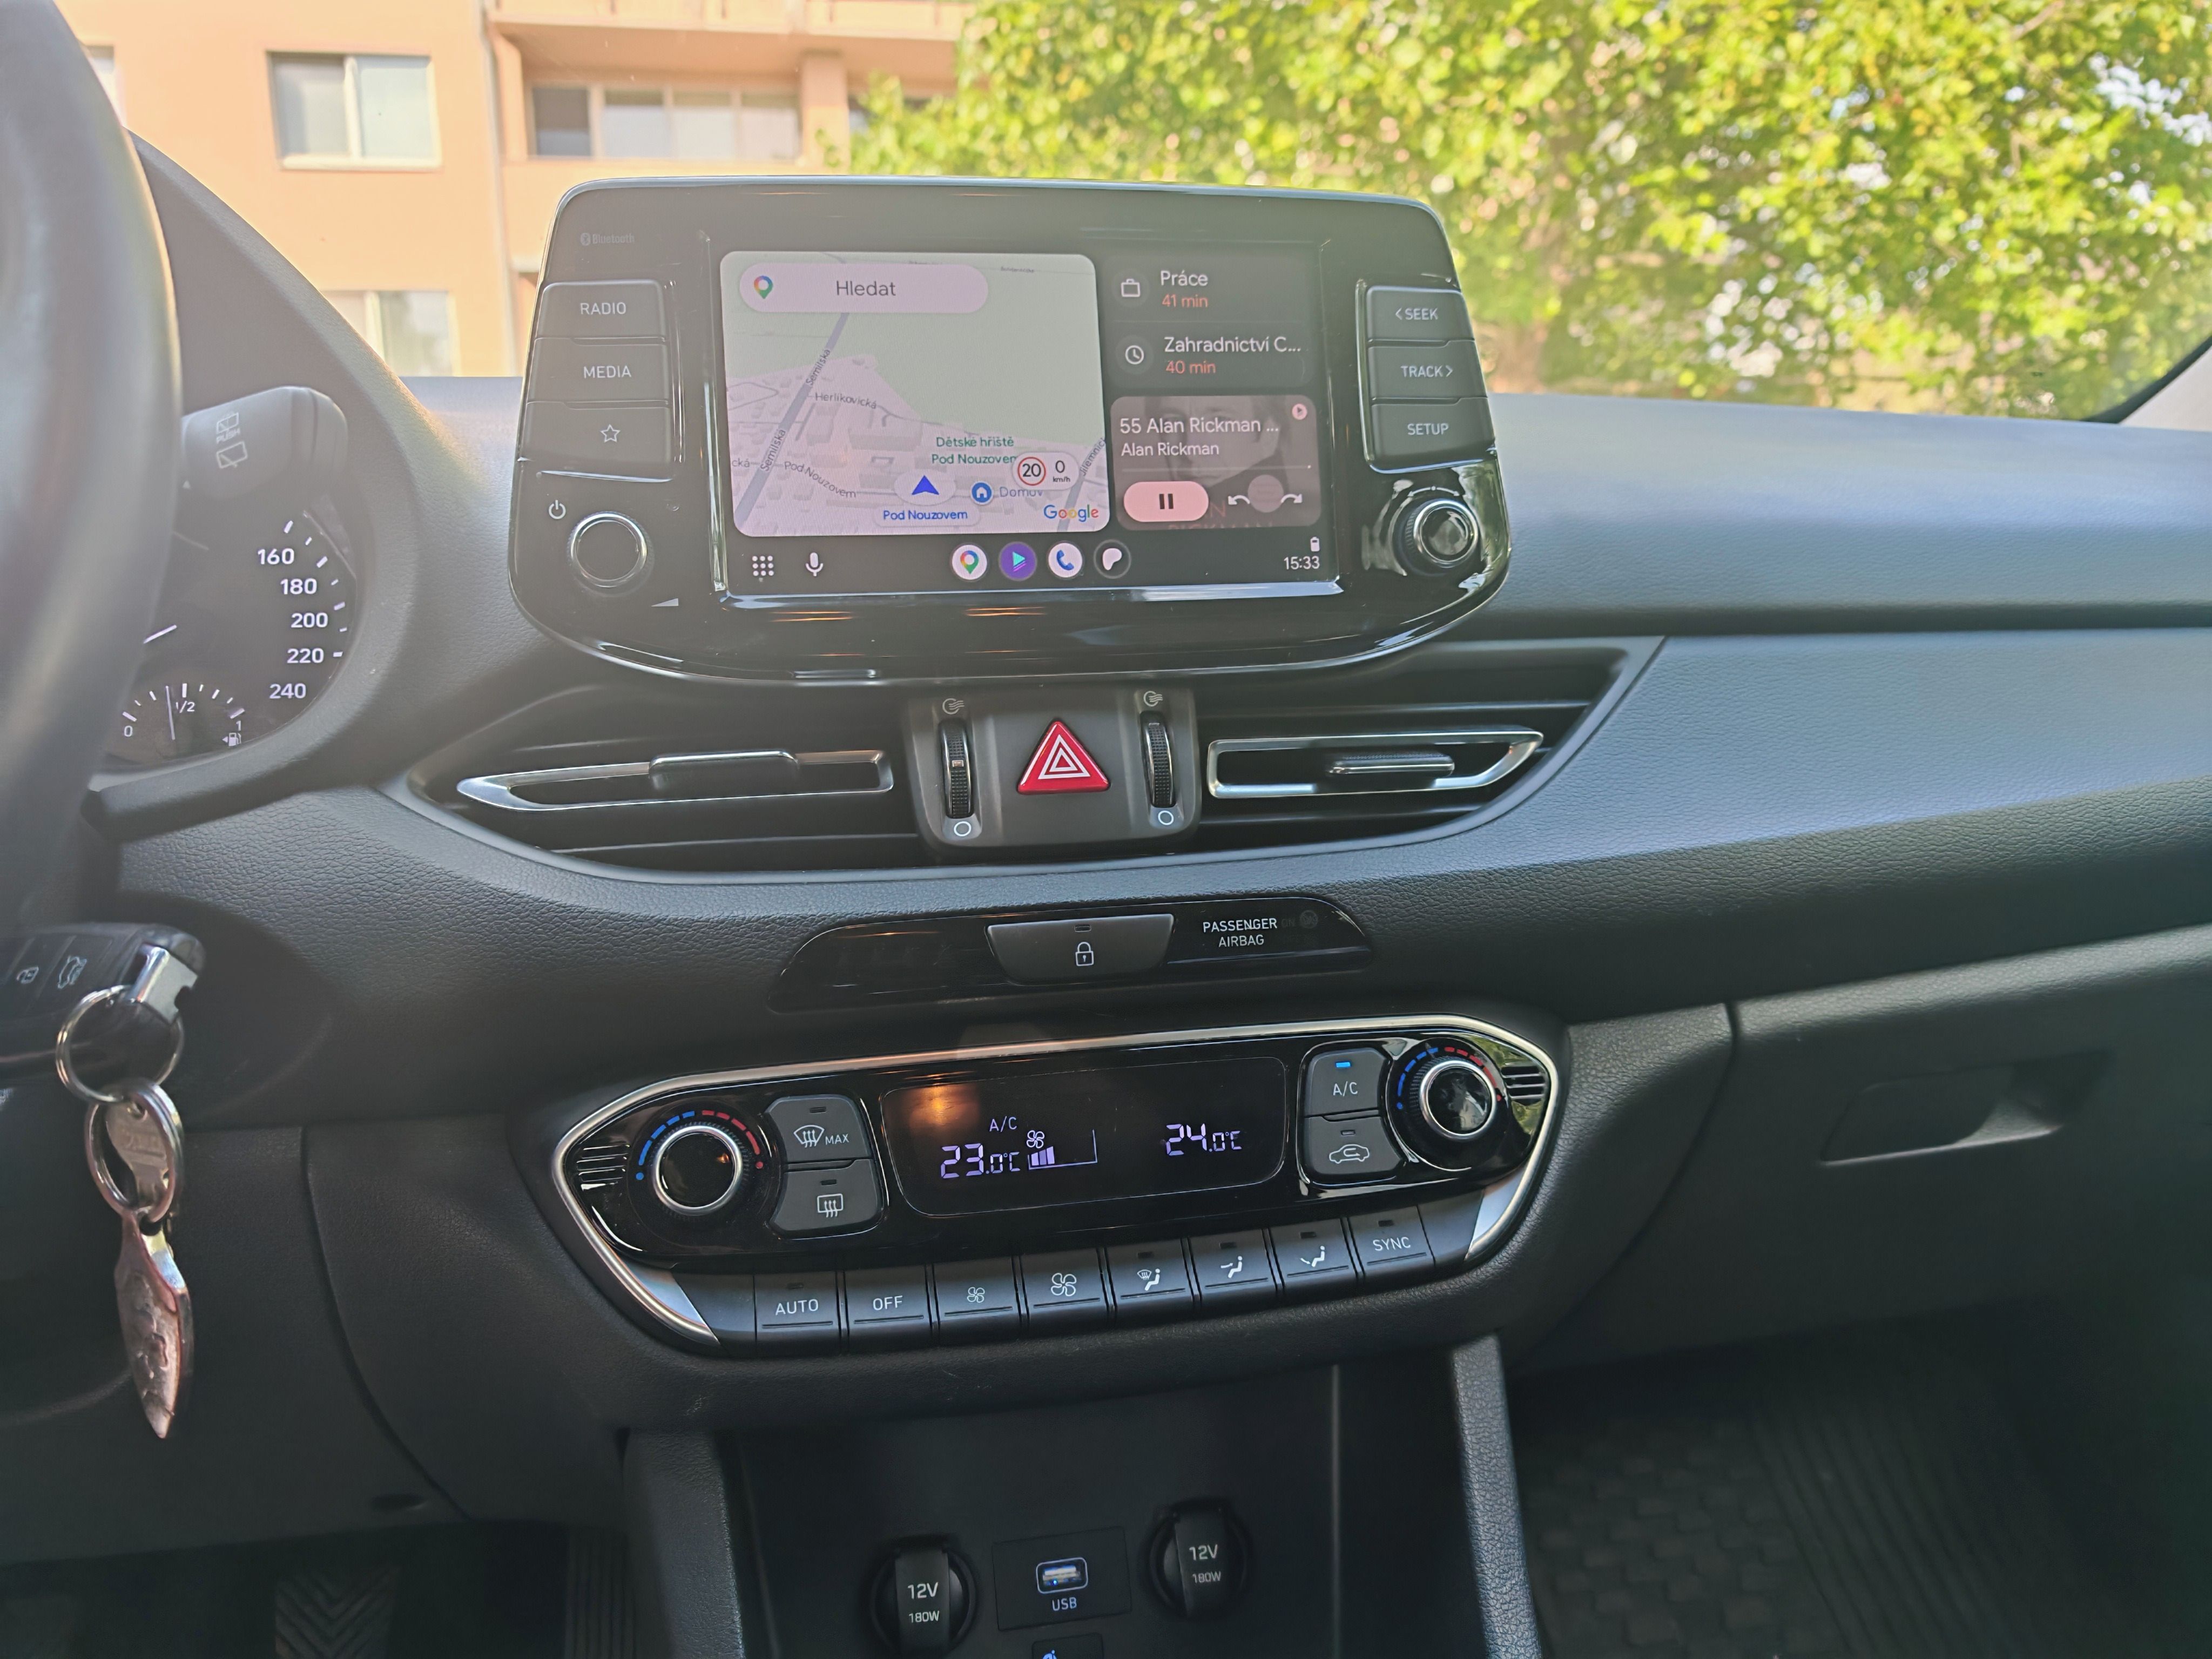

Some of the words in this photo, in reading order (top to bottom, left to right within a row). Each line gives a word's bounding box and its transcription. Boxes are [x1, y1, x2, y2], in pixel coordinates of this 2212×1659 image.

[592, 233, 635, 244] Bluetooth
[1161, 269, 1209, 287] Práce
[835, 280, 896, 297] Hledat
[580, 302, 626, 315] RADIO
[1162, 295, 1177, 308] 41
[1182, 294, 1209, 307] min
[1164, 336, 1270, 353] Zahradnictví
[583, 366, 631, 379] MEDIA
[1165, 361, 1185, 374] 40
[1190, 361, 1216, 374] min
[1120, 419, 1142, 434] 55
[1147, 418, 1185, 433] Alan
[1190, 417, 1261, 433] Rickman
[1407, 423, 1449, 435] SETUP
[936, 436, 977, 447] Dětské
[980, 436, 1014, 447] hřiště
[1121, 443, 1154, 457] Alan
[1158, 442, 1219, 456] Rickman
[932, 454, 954, 464] Pod
[1055, 460, 1065, 473] 0
[1022, 463, 1042, 477] 20
[784, 461, 804, 473] Pod
[805, 467, 856, 498] Nouzovem
[883, 509, 905, 520] Pod
[908, 509, 968, 520] Nouzovem
[1043, 504, 1099, 522] Google
[257, 548, 295, 565] 160
[1283, 555, 1320, 570] 15:33
[280, 578, 317, 595] 180
[291, 612, 328, 629] 200
[287, 648, 325, 664] 220
[269, 683, 307, 699] 240
[176, 700, 195, 713] 1/2
[124, 725, 133, 737] 0
[236, 720, 241, 731] 1
[1203, 918, 1278, 933] PASSENGER
[1219, 934, 1264, 948] AIRBAG
[1332, 1082, 1358, 1097] A/C
[989, 1116, 1017, 1132] A/C
[825, 1134, 849, 1144] MAX
[1372, 1237, 1411, 1252] SYNC
[775, 1299, 819, 1314] AUTO
[873, 1296, 903, 1311] OFF
[1189, 1545, 1219, 1561] 12V
[1192, 1571, 1222, 1584] 180W
[907, 1582, 939, 1600] 12V
[1052, 1597, 1078, 1611] USB
[908, 1610, 940, 1623] 180W
